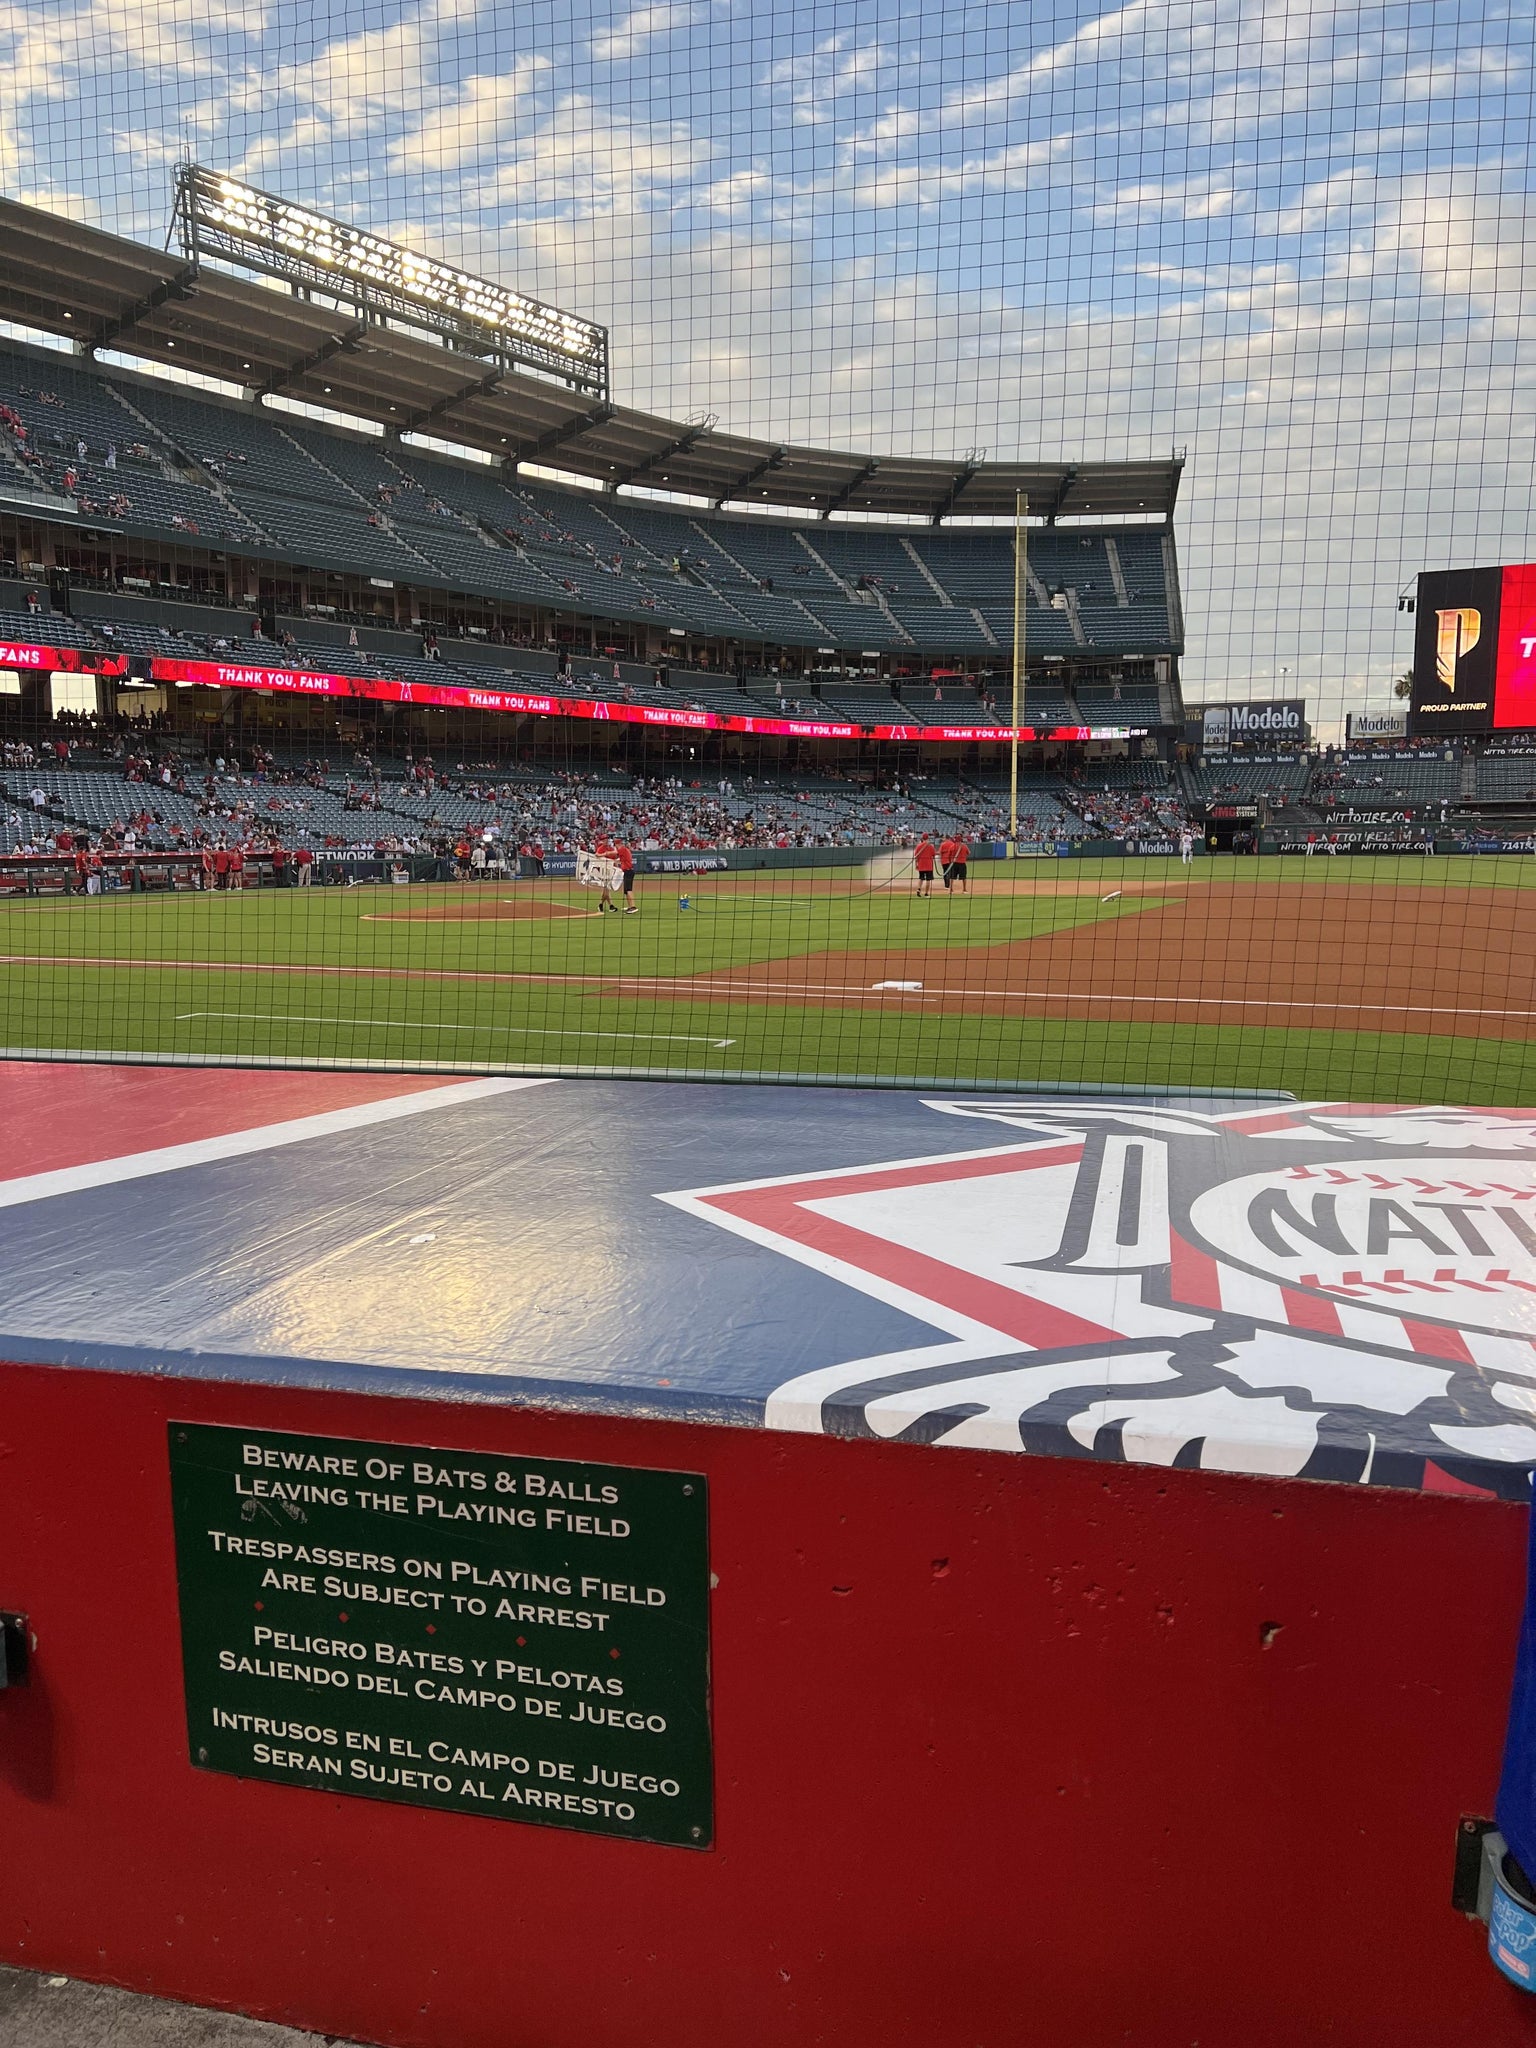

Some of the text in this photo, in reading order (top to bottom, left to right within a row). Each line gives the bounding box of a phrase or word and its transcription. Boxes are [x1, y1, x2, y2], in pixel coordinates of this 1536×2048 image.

[0, 648, 40, 664] FANS
[218, 668, 330, 690] THANK YOU, FANS
[469, 693, 550, 711] THANK YOU, FANS
[1420, 702, 1487, 713] PROUD PARTNER
[643, 710, 669, 721] THANK
[688, 715, 707, 725] FANS
[1231, 705, 1300, 731] Modelo
[1358, 716, 1400, 732] Modelo
[789, 723, 812, 734] THANK
[832, 727, 852, 735] FANS
[943, 729, 973, 738] THANK
[1483, 748, 1506, 756] NITTO
[312, 850, 375, 861] ETWORK
[1139, 841, 1174, 854] Modelo
[1281, 843, 1307, 851] NITTO
[663, 857, 718, 871] MLB NETWORK
[242, 1444, 620, 1505] BEWARE OF BATS & BALLS
[234, 1473, 631, 1538] LEAVING THE PLAYING FIELD
[207, 1530, 667, 1607] TRESPASSERS ON PLAYING FIELD
[260, 1568, 610, 1632] ARE SUBJECT TO ARREST
[253, 1625, 624, 1697] PELIGRO BATES Y PELOTAS
[218, 1650, 667, 1733] SALIENDO DEL CAMPO DE JUEGO
[212, 1707, 681, 1797] INTRUSOS EN EL CAMPO DE JUEGO
[253, 1743, 636, 1822] SERAN SUJETO AL ARRESTO
[1493, 1893, 1524, 1927] Polar
[1498, 1919, 1530, 1954] Pop
